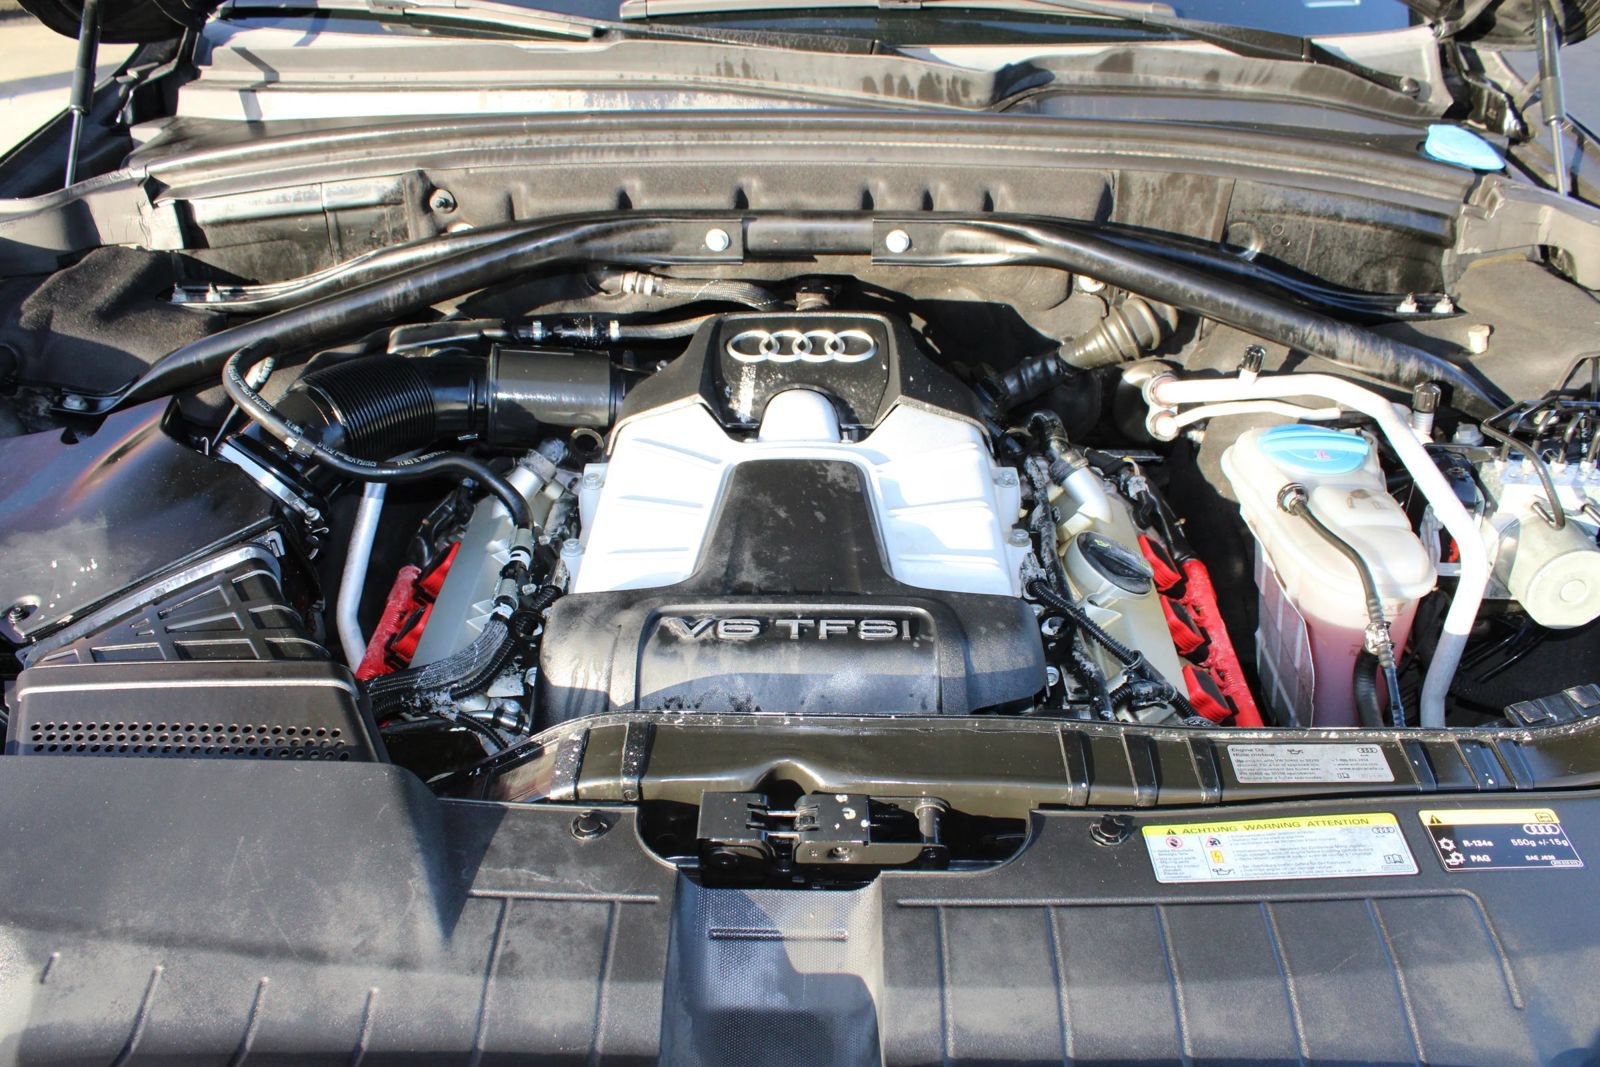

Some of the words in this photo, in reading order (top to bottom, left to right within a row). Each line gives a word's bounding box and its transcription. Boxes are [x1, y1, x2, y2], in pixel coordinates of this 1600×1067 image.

[665, 615, 761, 640] V6
[776, 618, 912, 641] TFSI
[1182, 826, 1238, 835] ACHTUNG
[1244, 821, 1301, 831] WARNING
[1307, 817, 1370, 827] ATTENTION
[1462, 839, 1494, 847] R-134a
[1510, 838, 1537, 847] 550g
[1470, 854, 1492, 862] PAG
